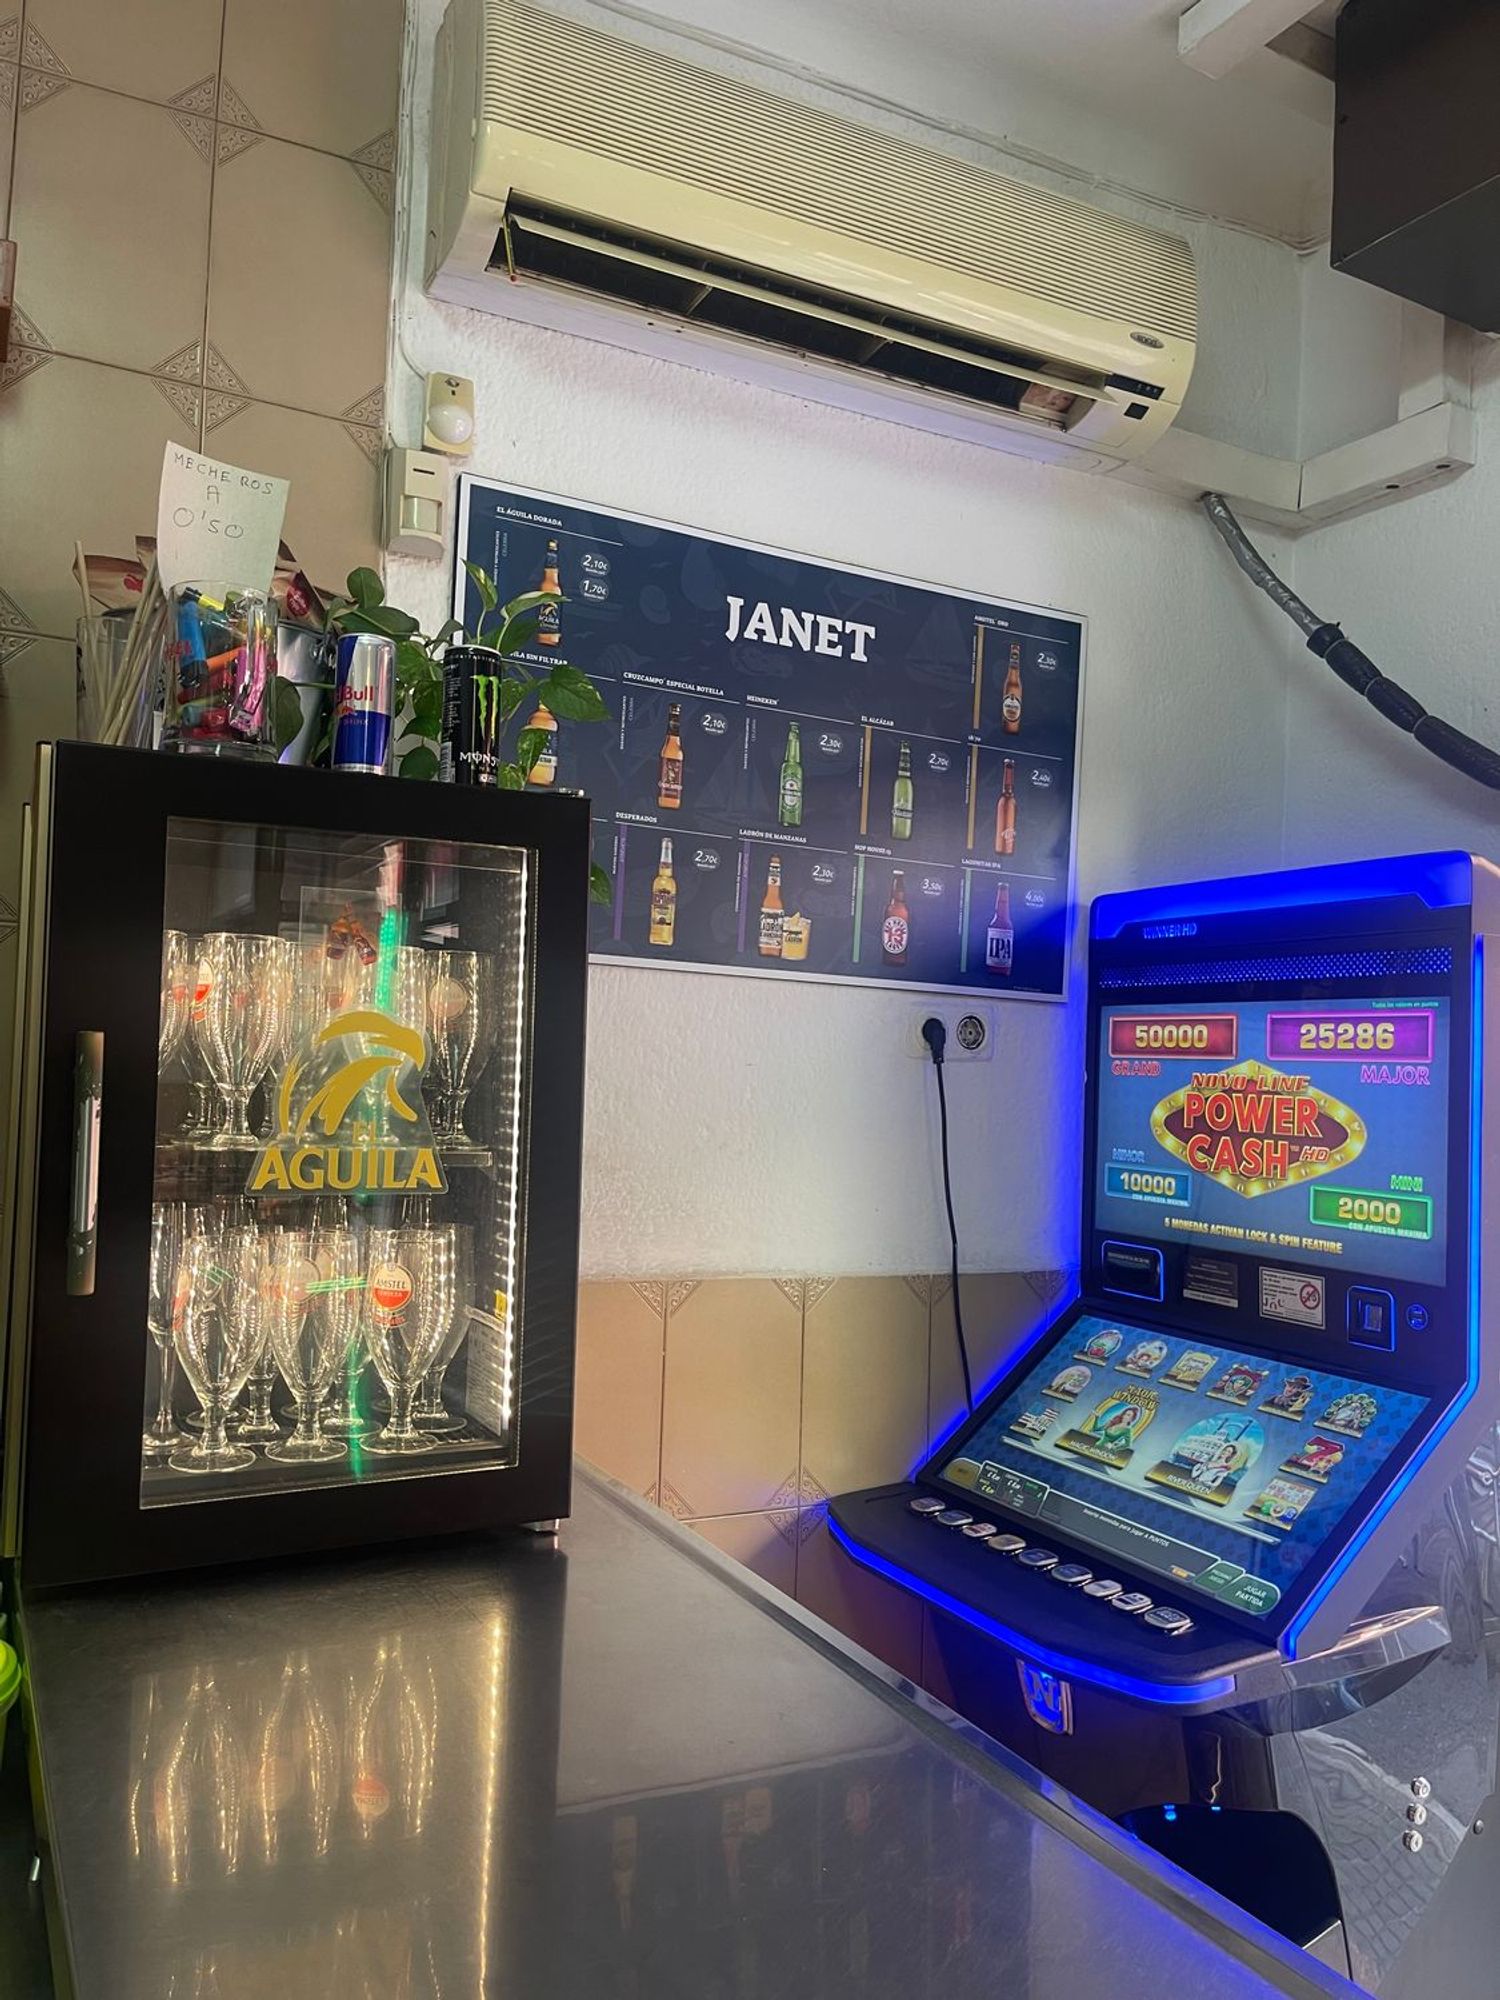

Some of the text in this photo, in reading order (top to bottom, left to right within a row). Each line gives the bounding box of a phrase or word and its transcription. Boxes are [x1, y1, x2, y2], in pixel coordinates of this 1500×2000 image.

[206, 485, 220, 505] A
[507, 507, 533, 520] ÁGUILA
[533, 514, 563, 527] DORADA
[725, 595, 876, 663] JANET
[526, 653, 538, 661] SIN
[343, 686, 373, 701] Bull
[622, 672, 724, 696] CRUZCAMPO ESPECIAL BOTELLA
[746, 694, 778, 706] HEINEKEN
[460, 750, 500, 767] MONS
[616, 812, 658, 824] DESPERADOS
[739, 828, 764, 838] LADRÓN
[773, 833, 807, 844] MANZANAS
[989, 937, 1011, 959] IPA
[1134, 1024, 1208, 1049] 50000
[1300, 1022, 1395, 1050] 25286
[1111, 1060, 1162, 1076] GRAND
[1360, 1064, 1430, 1085] MAJOR
[1257, 1073, 1311, 1093] LINE
[1183, 1092, 1322, 1138] POWER
[1186, 1134, 1330, 1180] CASH HD
[1120, 1172, 1176, 1196] 10000
[1390, 1174, 1423, 1192] MINI
[1338, 1196, 1402, 1225] 2000
[1164, 1217, 1343, 1254] 5 MONEDAS ACTIVAN LOCK & SPIN FEATURE
[1148, 1534, 1170, 1548] PUNTOS
